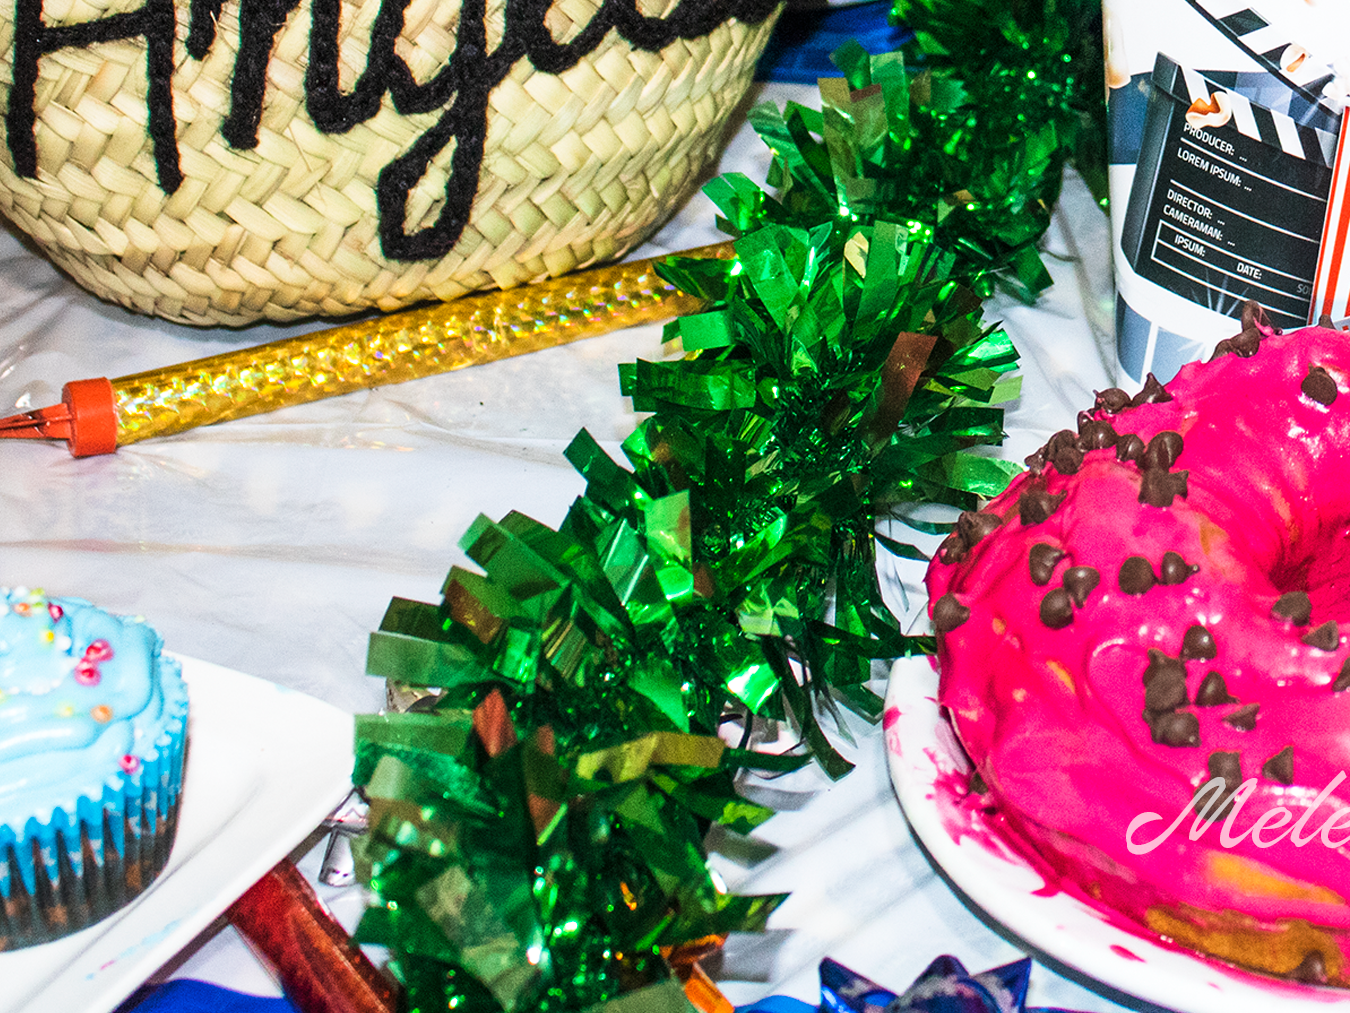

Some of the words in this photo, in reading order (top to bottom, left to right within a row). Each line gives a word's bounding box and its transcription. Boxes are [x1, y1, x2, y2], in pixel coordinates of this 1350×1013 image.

[1183, 121, 1235, 156] PRODUCER:
[1177, 147, 1209, 172] LOREM
[1209, 166, 1242, 187] IPSUM:
[1166, 189, 1213, 220] DIRECTOR:
[1162, 204, 1223, 241] CAMERAMAN:
[1174, 234, 1206, 257] IPSUM:
[1236, 261, 1263, 280] DATE:
